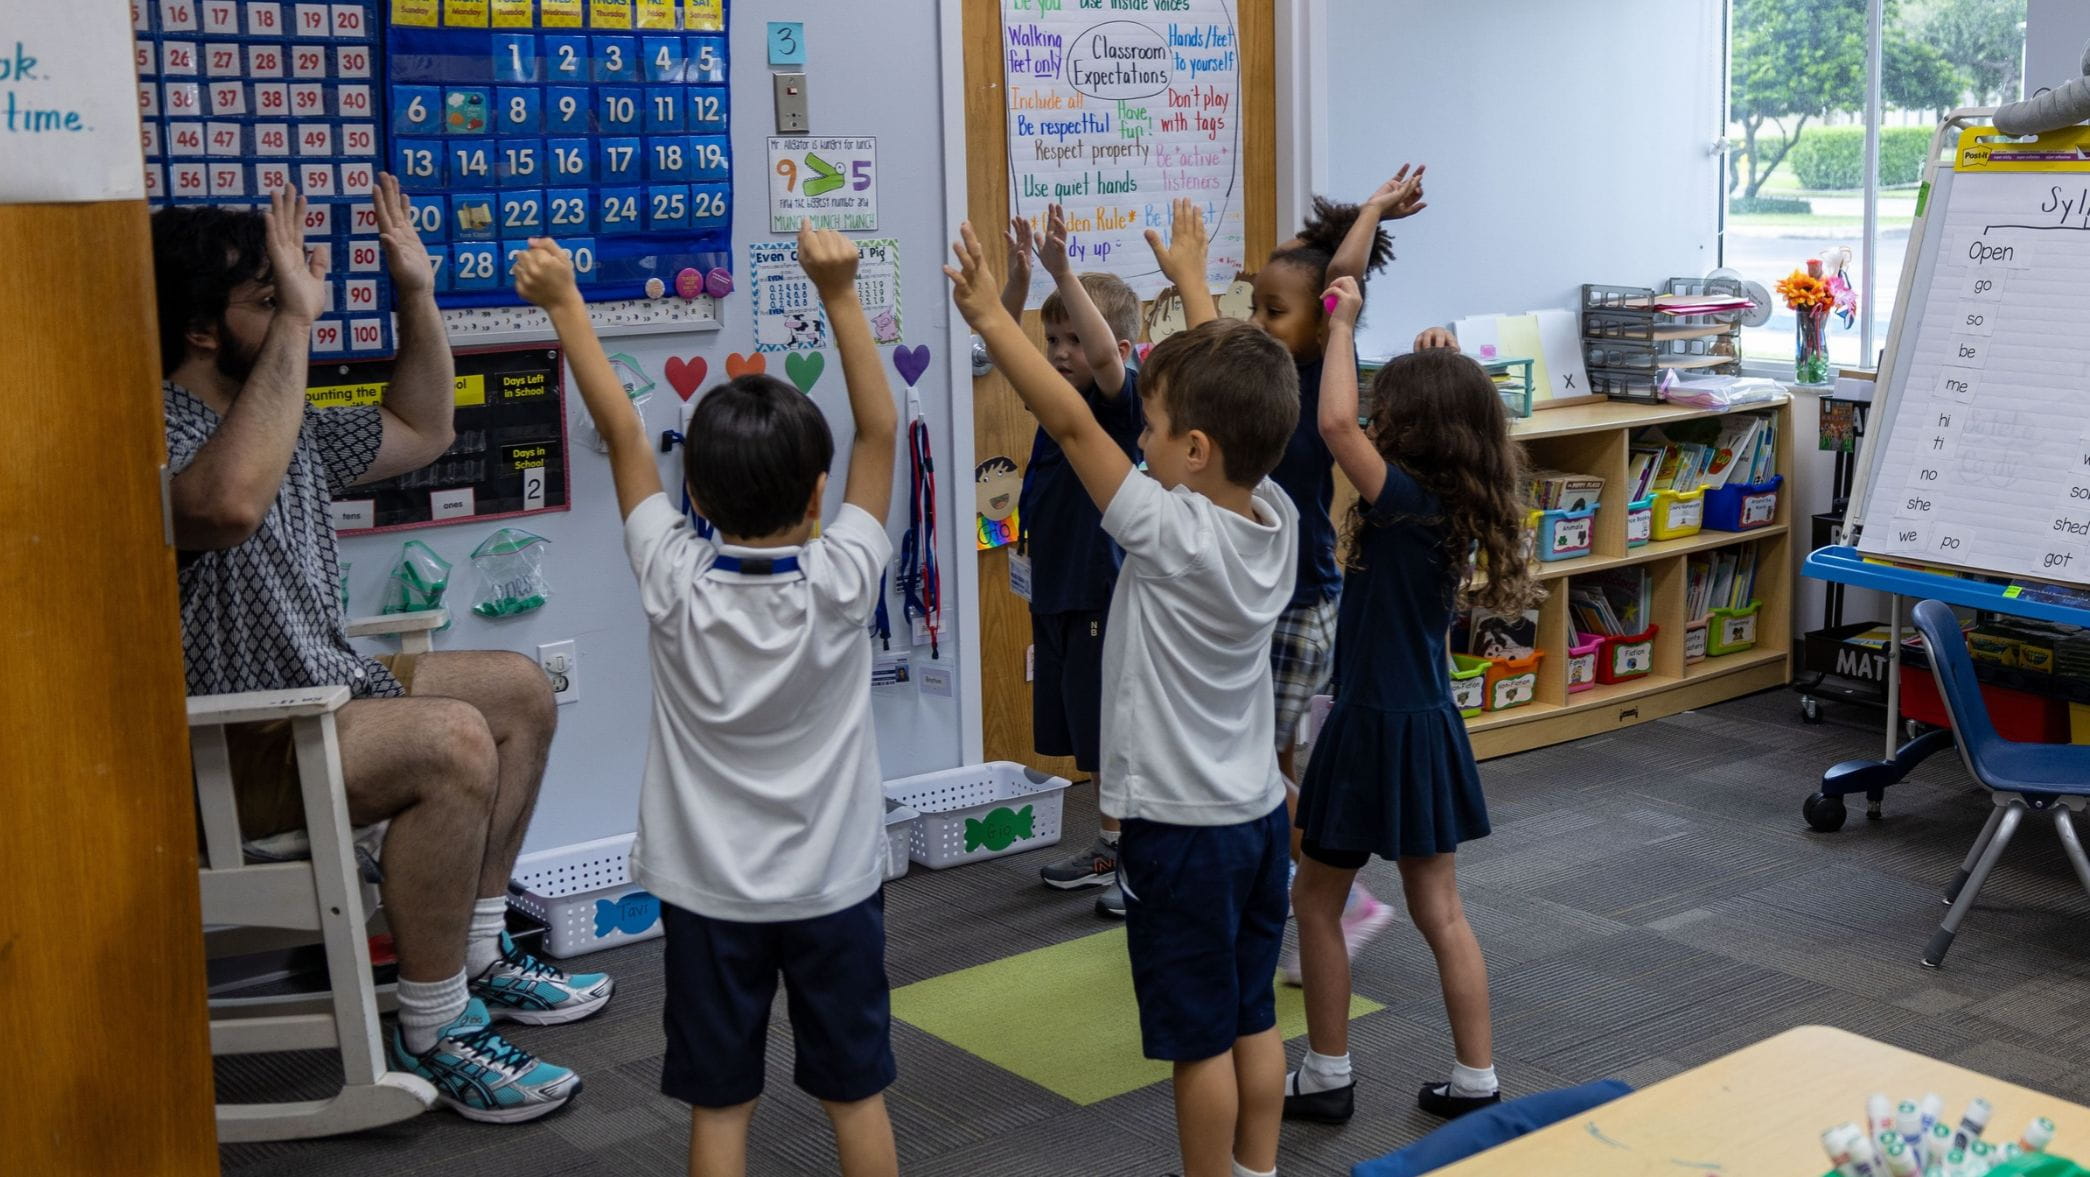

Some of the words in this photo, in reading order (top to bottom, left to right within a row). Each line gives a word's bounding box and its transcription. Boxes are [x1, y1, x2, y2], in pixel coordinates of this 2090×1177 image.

[1039, 0, 1063, 18] you
[1111, 0, 1148, 10] inside
[1155, 0, 1190, 10] voices
[169, 7, 188, 22] 16
[212, 10, 228, 25] 17
[257, 12, 274, 27] 18
[304, 13, 321, 28] 19
[338, 13, 359, 28] 20
[777, 27, 797, 56] 3
[1008, 24, 1062, 56] Walking
[1168, 23, 1235, 48] Hands/feet
[1092, 34, 1166, 60] Classroom
[170, 50, 191, 66] 26
[213, 52, 233, 68] 27
[256, 53, 277, 69] 28
[299, 53, 319, 69] 29
[343, 54, 365, 70] 30
[508, 45, 520, 71] 1
[559, 45, 575, 71] 2
[606, 45, 622, 71] 3
[656, 45, 671, 71] 4
[699, 45, 714, 71] 5
[1009, 49, 1030, 73] feet
[1034, 50, 1062, 80] only
[1173, 52, 1187, 71] to
[1189, 51, 1235, 79] yourself
[1074, 60, 1168, 92] Expectations
[173, 91, 192, 107] 36
[218, 90, 237, 106] 37
[262, 91, 282, 107] 38
[297, 91, 317, 107] 39
[343, 93, 366, 109] 40
[1010, 86, 1063, 111] Include
[1068, 92, 1085, 110] all
[1168, 87, 1199, 108] Don't
[1203, 86, 1229, 111] play
[3, 92, 95, 134] time.
[408, 97, 427, 122] 6
[510, 98, 527, 123] 8
[559, 97, 576, 122] 9
[606, 98, 634, 123] 10
[654, 97, 673, 122] 11
[694, 97, 719, 122] 12
[1117, 100, 1149, 121] Have
[1018, 115, 1034, 136] Be
[1040, 113, 1110, 143] respectful
[1160, 112, 1188, 133] with
[1194, 111, 1225, 141] tags
[177, 131, 199, 147] 46
[214, 131, 234, 147] 47
[261, 131, 283, 147] 48
[305, 131, 326, 147] 49
[348, 131, 370, 147] 50
[403, 150, 433, 176] 13
[457, 150, 487, 176] 14
[506, 149, 534, 175] 15
[555, 149, 583, 175] 16
[607, 147, 633, 173] 17
[656, 145, 683, 171] 18
[695, 144, 721, 170] 19
[1035, 139, 1084, 168] Respect
[1092, 136, 1149, 166] property
[1156, 145, 1172, 167] Be
[180, 172, 200, 188] 56
[217, 172, 236, 188] 57
[264, 172, 283, 188] 58
[308, 172, 328, 188] 59
[348, 172, 369, 188] 60
[775, 159, 797, 193] 9
[852, 160, 872, 192] 5
[1162, 170, 1220, 191] listeners
[1023, 174, 1048, 197] Use
[1054, 172, 1089, 204] quiet
[1097, 170, 1137, 194] hands
[410, 206, 441, 232] 20
[504, 201, 540, 227] 22
[551, 199, 585, 225] 23
[604, 197, 638, 223] 24
[653, 195, 685, 220] 25
[695, 192, 726, 218] 26
[1145, 203, 1161, 226] Be
[2041, 185, 2090, 224] Syl
[305, 212, 325, 228] 69
[357, 212, 376, 227] 70
[354, 249, 375, 265] 80
[756, 252, 785, 263] Even
[870, 246, 886, 262] Pig
[1094, 242, 1110, 262] up
[1969, 241, 2014, 264] Open
[458, 252, 494, 279] 28
[351, 287, 371, 303] 90
[1974, 279, 1992, 294] go
[1966, 314, 1984, 327] so
[317, 328, 337, 344] 99
[354, 326, 378, 343] 100
[1958, 343, 1976, 358] be
[503, 376, 525, 386] Days
[526, 374, 544, 385] Left
[1946, 379, 1968, 393] me
[304, 386, 353, 402] ounting
[356, 387, 377, 398] the
[504, 388, 513, 398] in
[514, 386, 545, 397] School
[1939, 413, 1951, 427] hi
[1933, 435, 1944, 450] ti
[513, 448, 534, 459] Days
[536, 447, 545, 456] in
[515, 459, 544, 470] School
[1920, 468, 1938, 481] no
[528, 478, 541, 499] 2
[443, 501, 463, 510] ones
[1906, 497, 1931, 512] she
[342, 512, 361, 521] tens
[1899, 530, 1918, 543] we
[2053, 518, 2089, 536] shed
[1940, 535, 1960, 550] po
[2044, 552, 2073, 568] got
[1835, 648, 1888, 681] MAT
